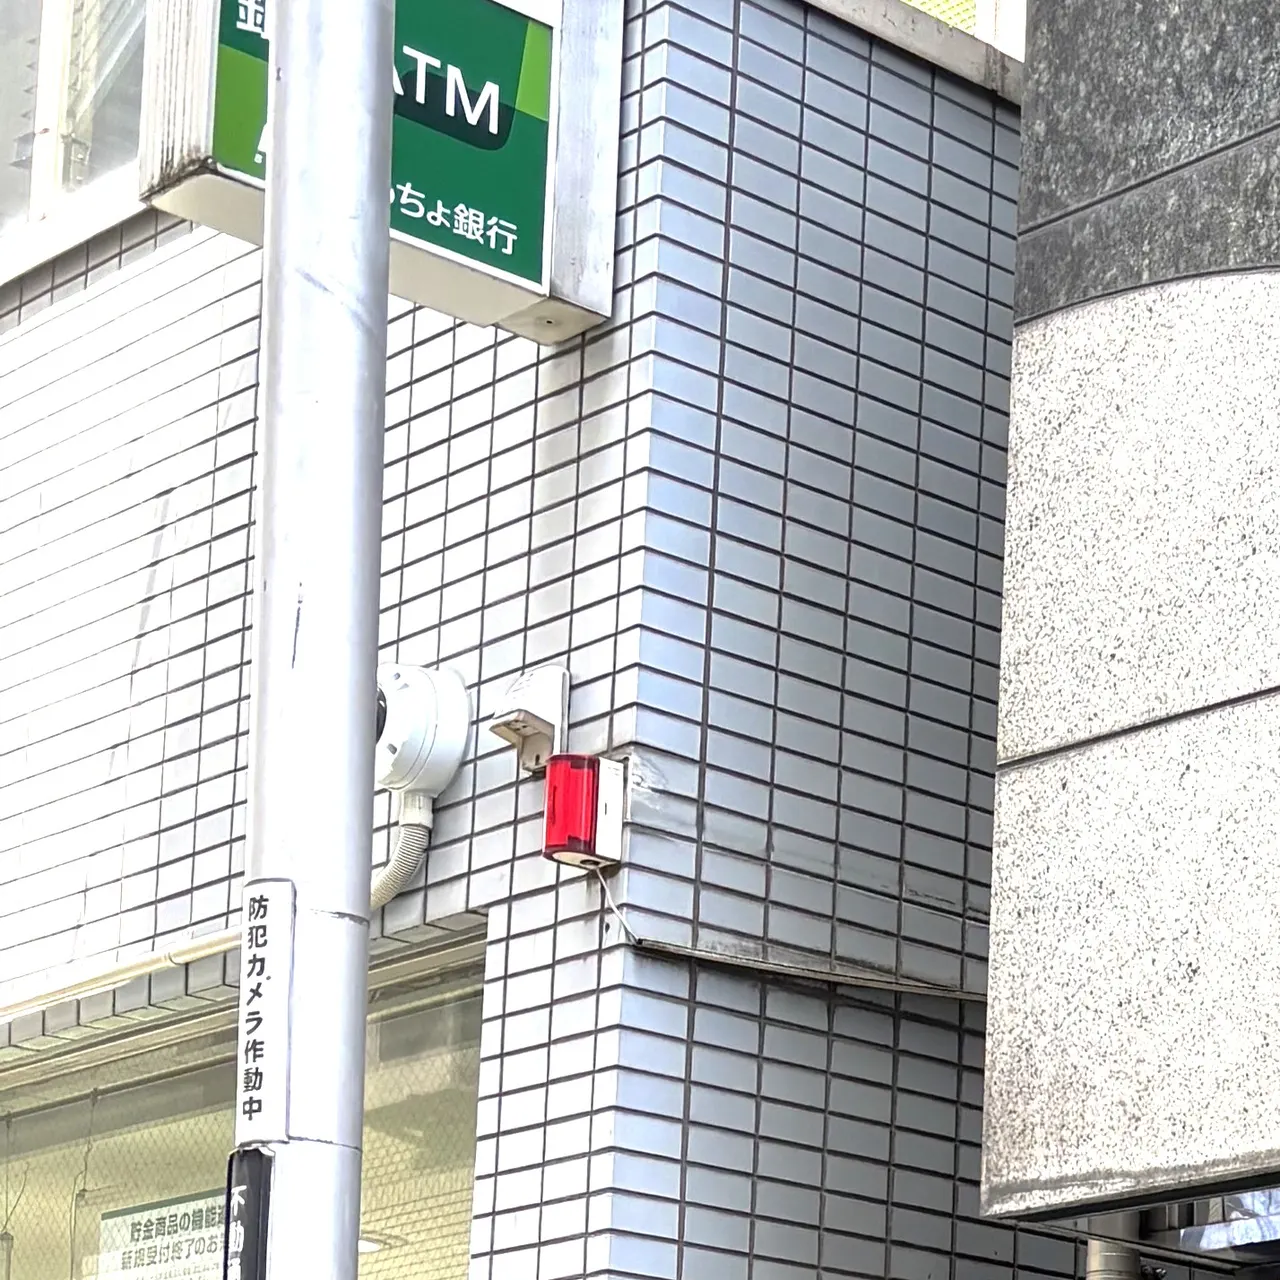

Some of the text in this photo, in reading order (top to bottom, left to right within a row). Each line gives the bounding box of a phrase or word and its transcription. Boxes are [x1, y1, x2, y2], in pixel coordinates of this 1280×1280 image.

[390, 182, 518, 256] ちょ銀行
[242, 894, 270, 1121] 防犯カメラ作動中
